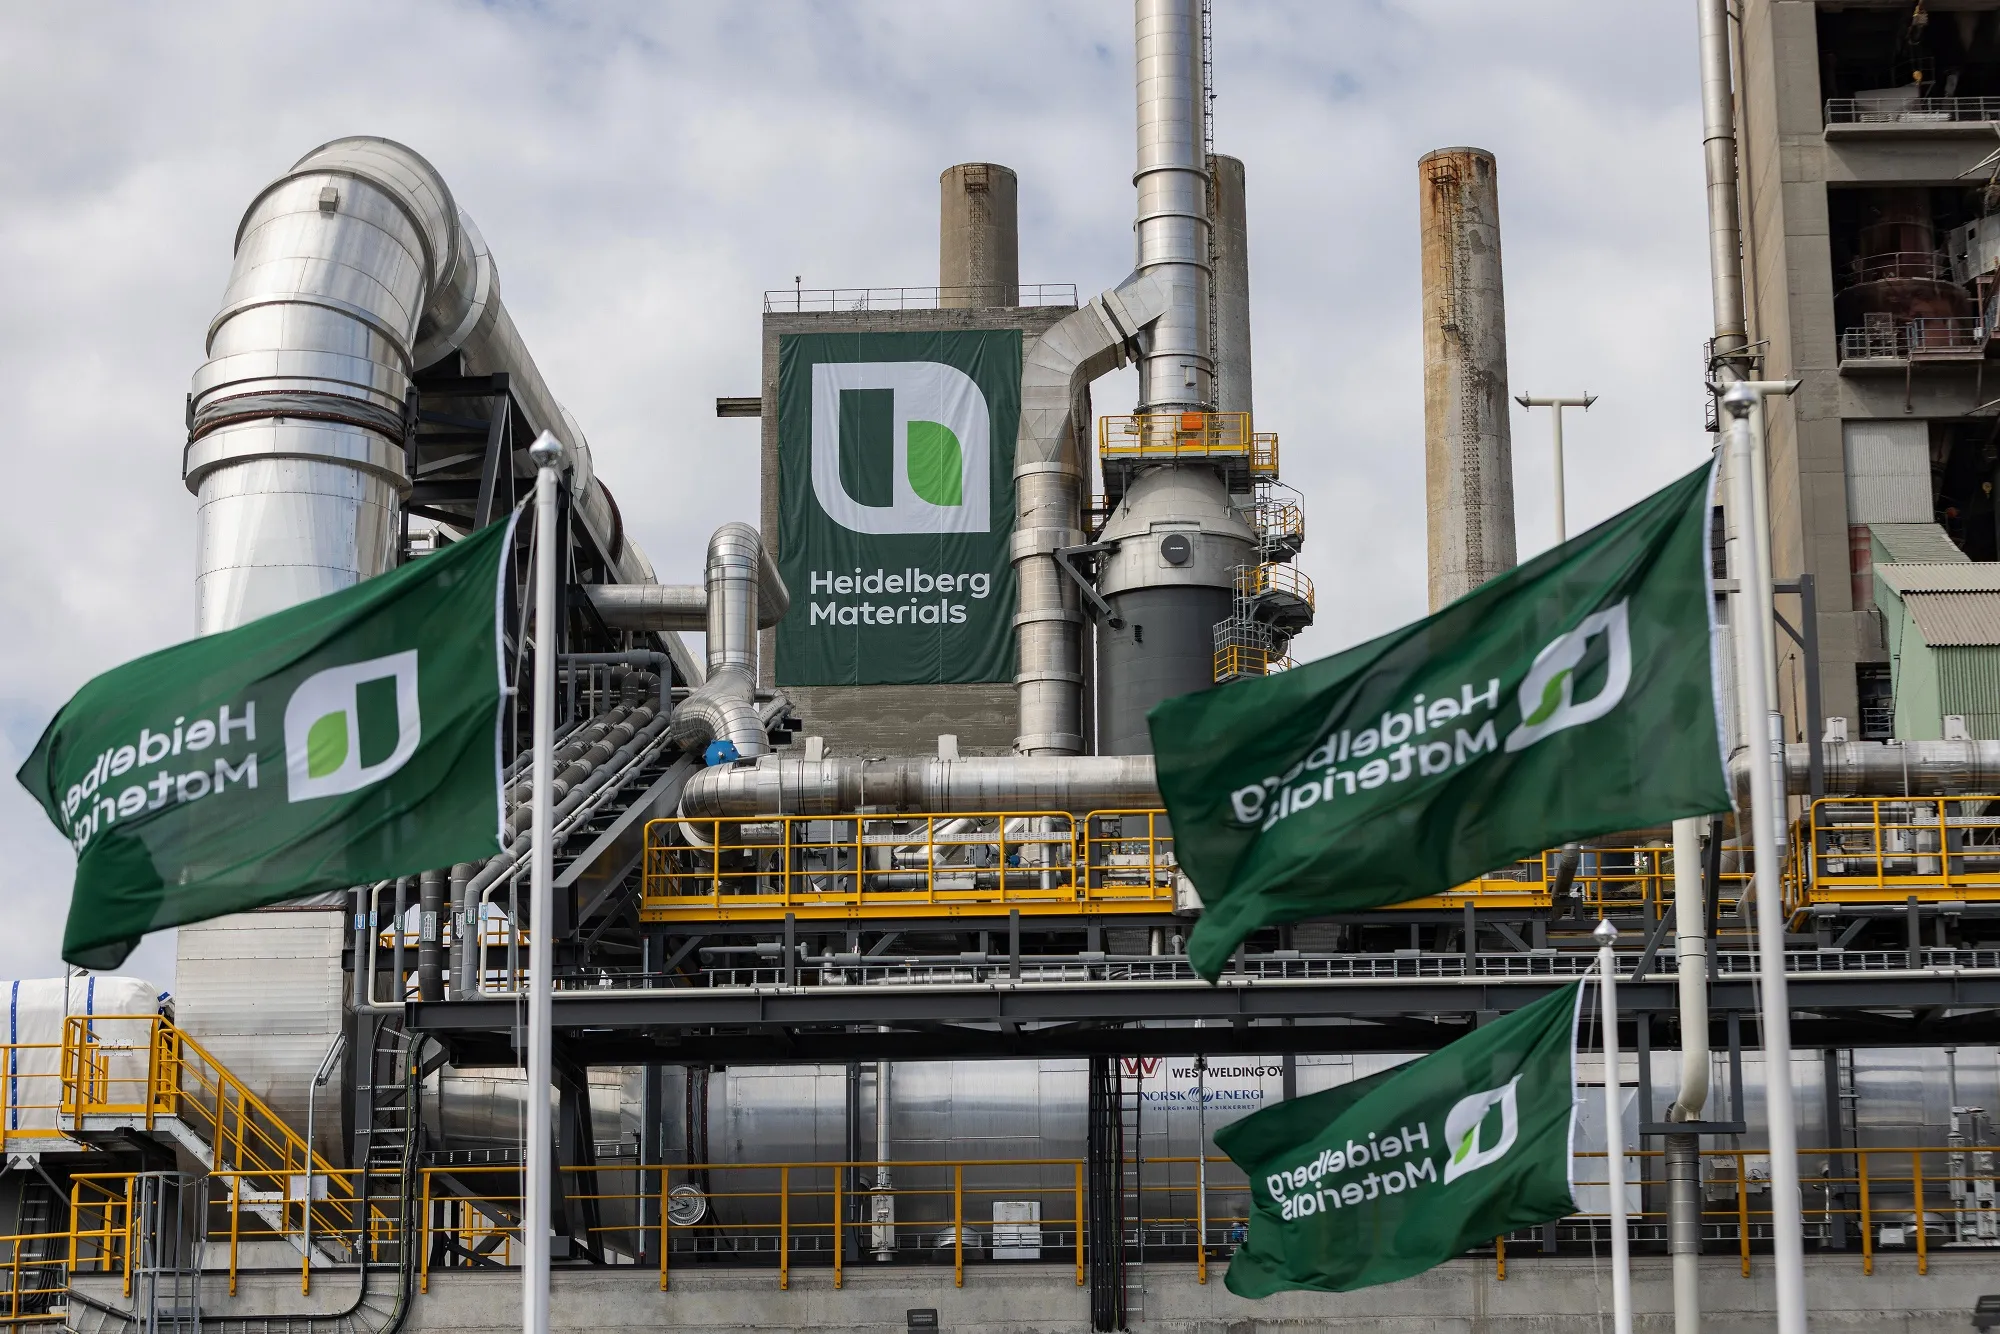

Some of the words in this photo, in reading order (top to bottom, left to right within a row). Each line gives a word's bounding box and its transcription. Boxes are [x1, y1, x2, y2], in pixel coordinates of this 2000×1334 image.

[810, 567, 990, 599] Heidelberg
[810, 597, 967, 626] Materials
[1172, 1068, 1199, 1079] WES
[1207, 1066, 1265, 1078] WELDING
[1267, 1066, 1284, 1077] OY
[1140, 1090, 1187, 1101] NORSK
[1215, 1089, 1264, 1100] ENERGI
